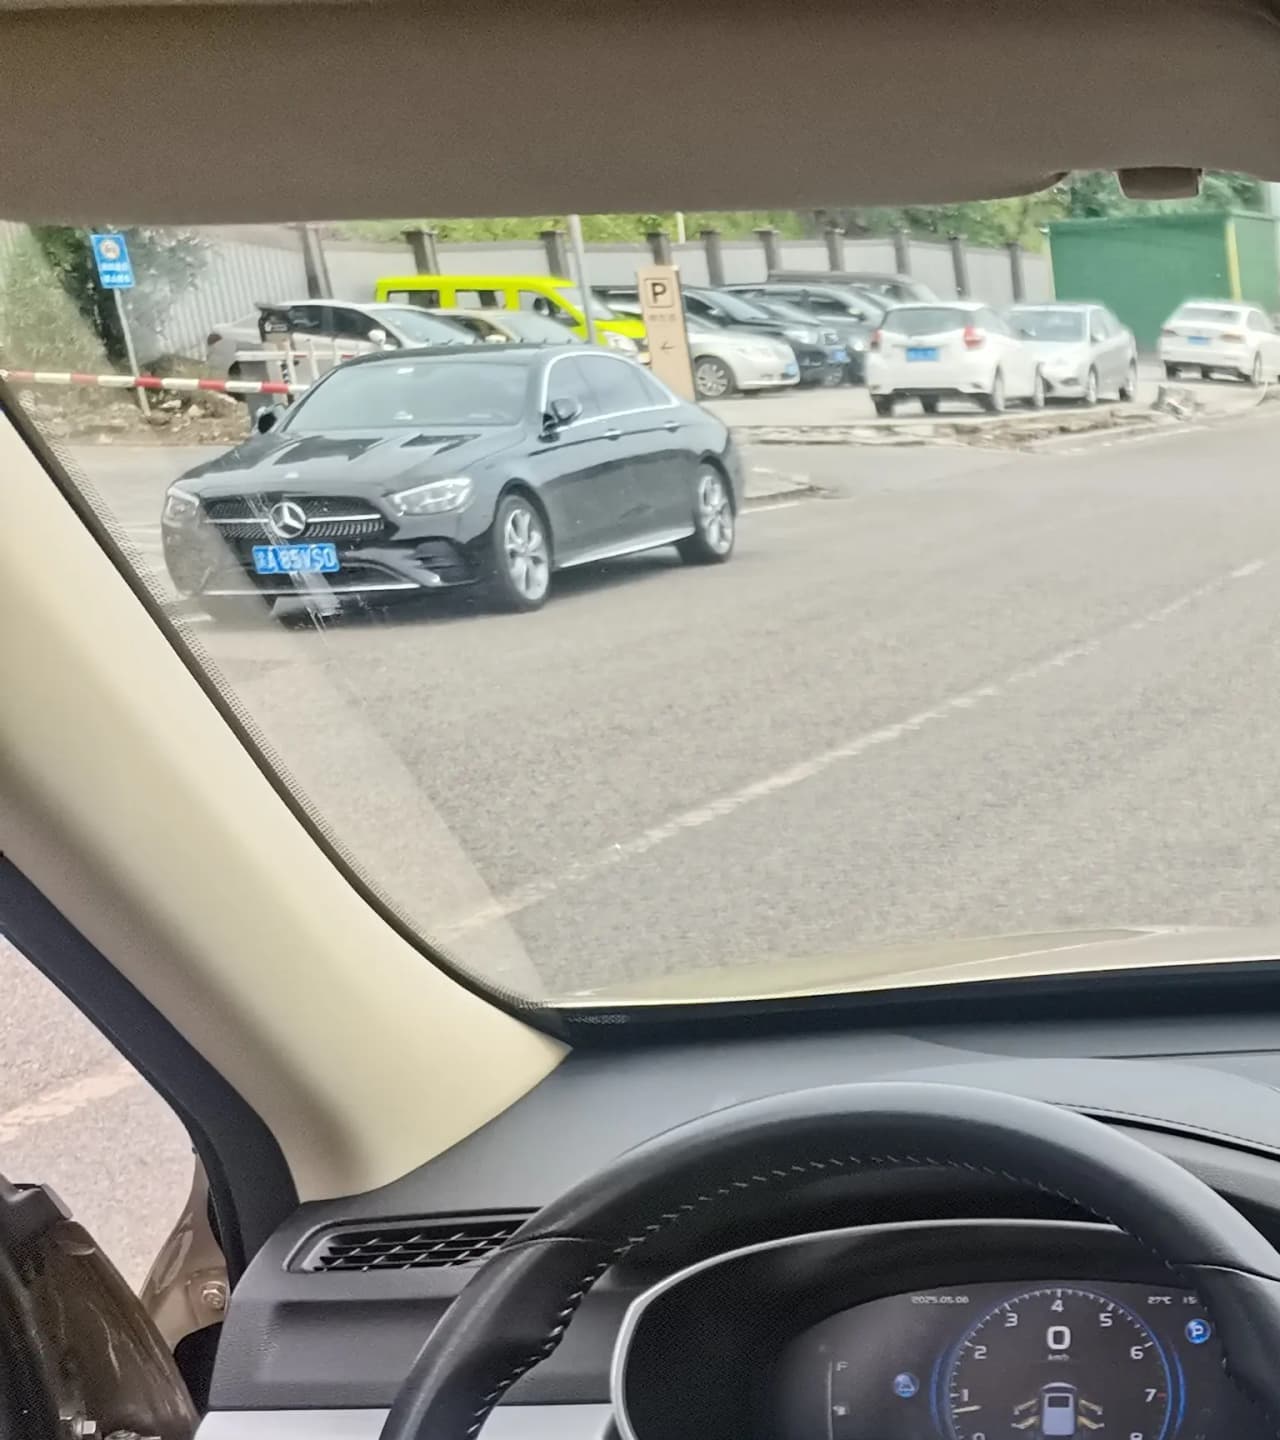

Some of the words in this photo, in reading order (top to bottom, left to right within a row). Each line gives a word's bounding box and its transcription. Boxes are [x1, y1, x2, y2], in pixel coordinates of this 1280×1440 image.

[651, 282, 667, 303] P
[1051, 1300, 1064, 1312] 4
[1005, 1313, 1018, 1327] 3
[1100, 1313, 1113, 1327] 5
[1047, 1326, 1071, 1350] 0
[974, 1346, 987, 1359] 2
[1130, 1346, 1144, 1359] 6
[961, 1389, 969, 1401] 1
[1145, 1389, 1156, 1402] 7
